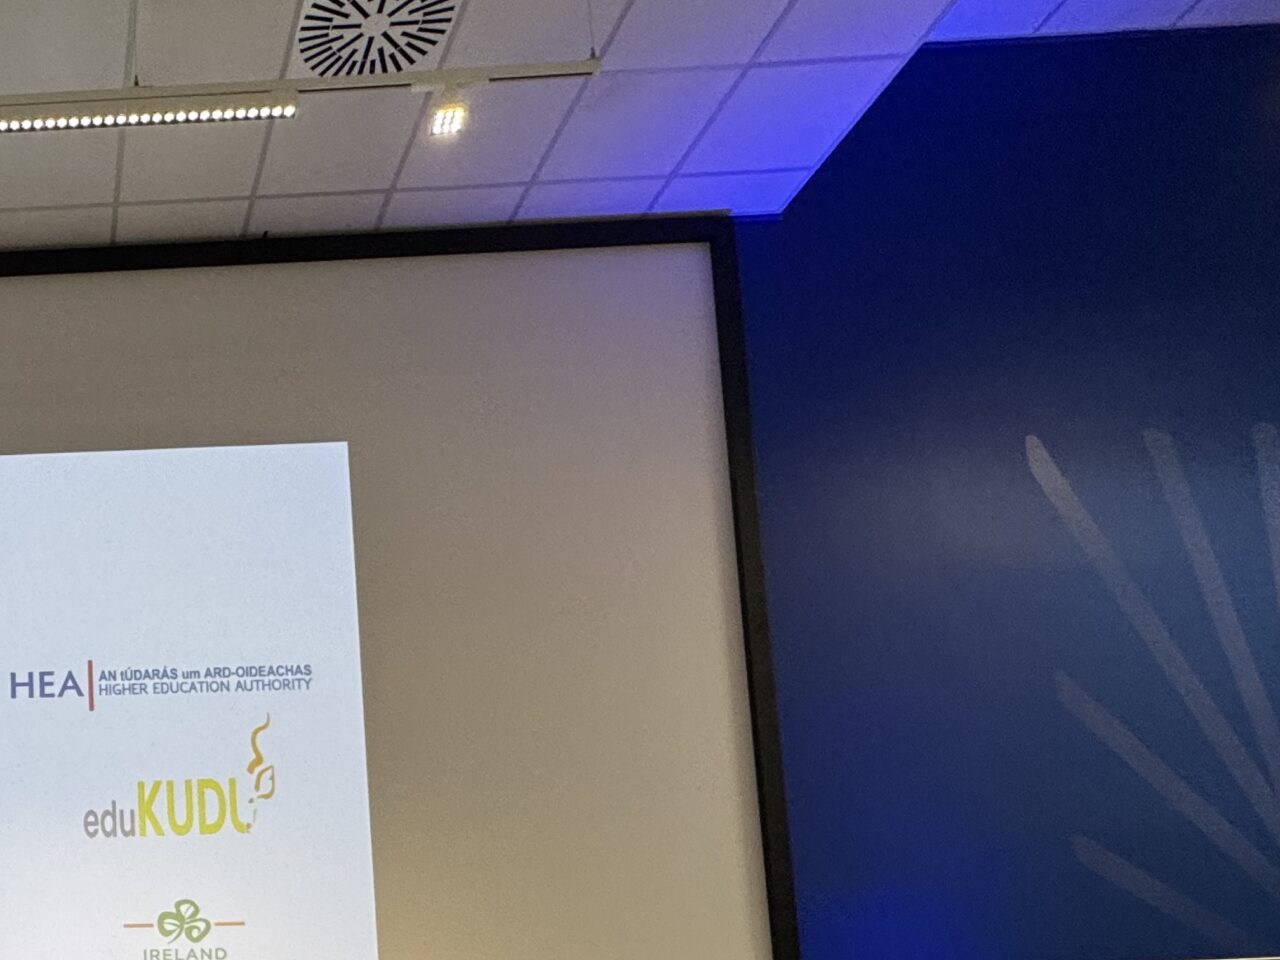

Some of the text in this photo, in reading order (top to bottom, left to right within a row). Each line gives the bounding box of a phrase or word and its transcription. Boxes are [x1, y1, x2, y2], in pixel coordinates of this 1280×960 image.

[99, 664, 312, 682] AN tÚDARÁS um ARD-OIDEACHAS
[10, 670, 84, 699] HEA
[98, 678, 312, 696] HIGHER EDUCATION AUTHORITY
